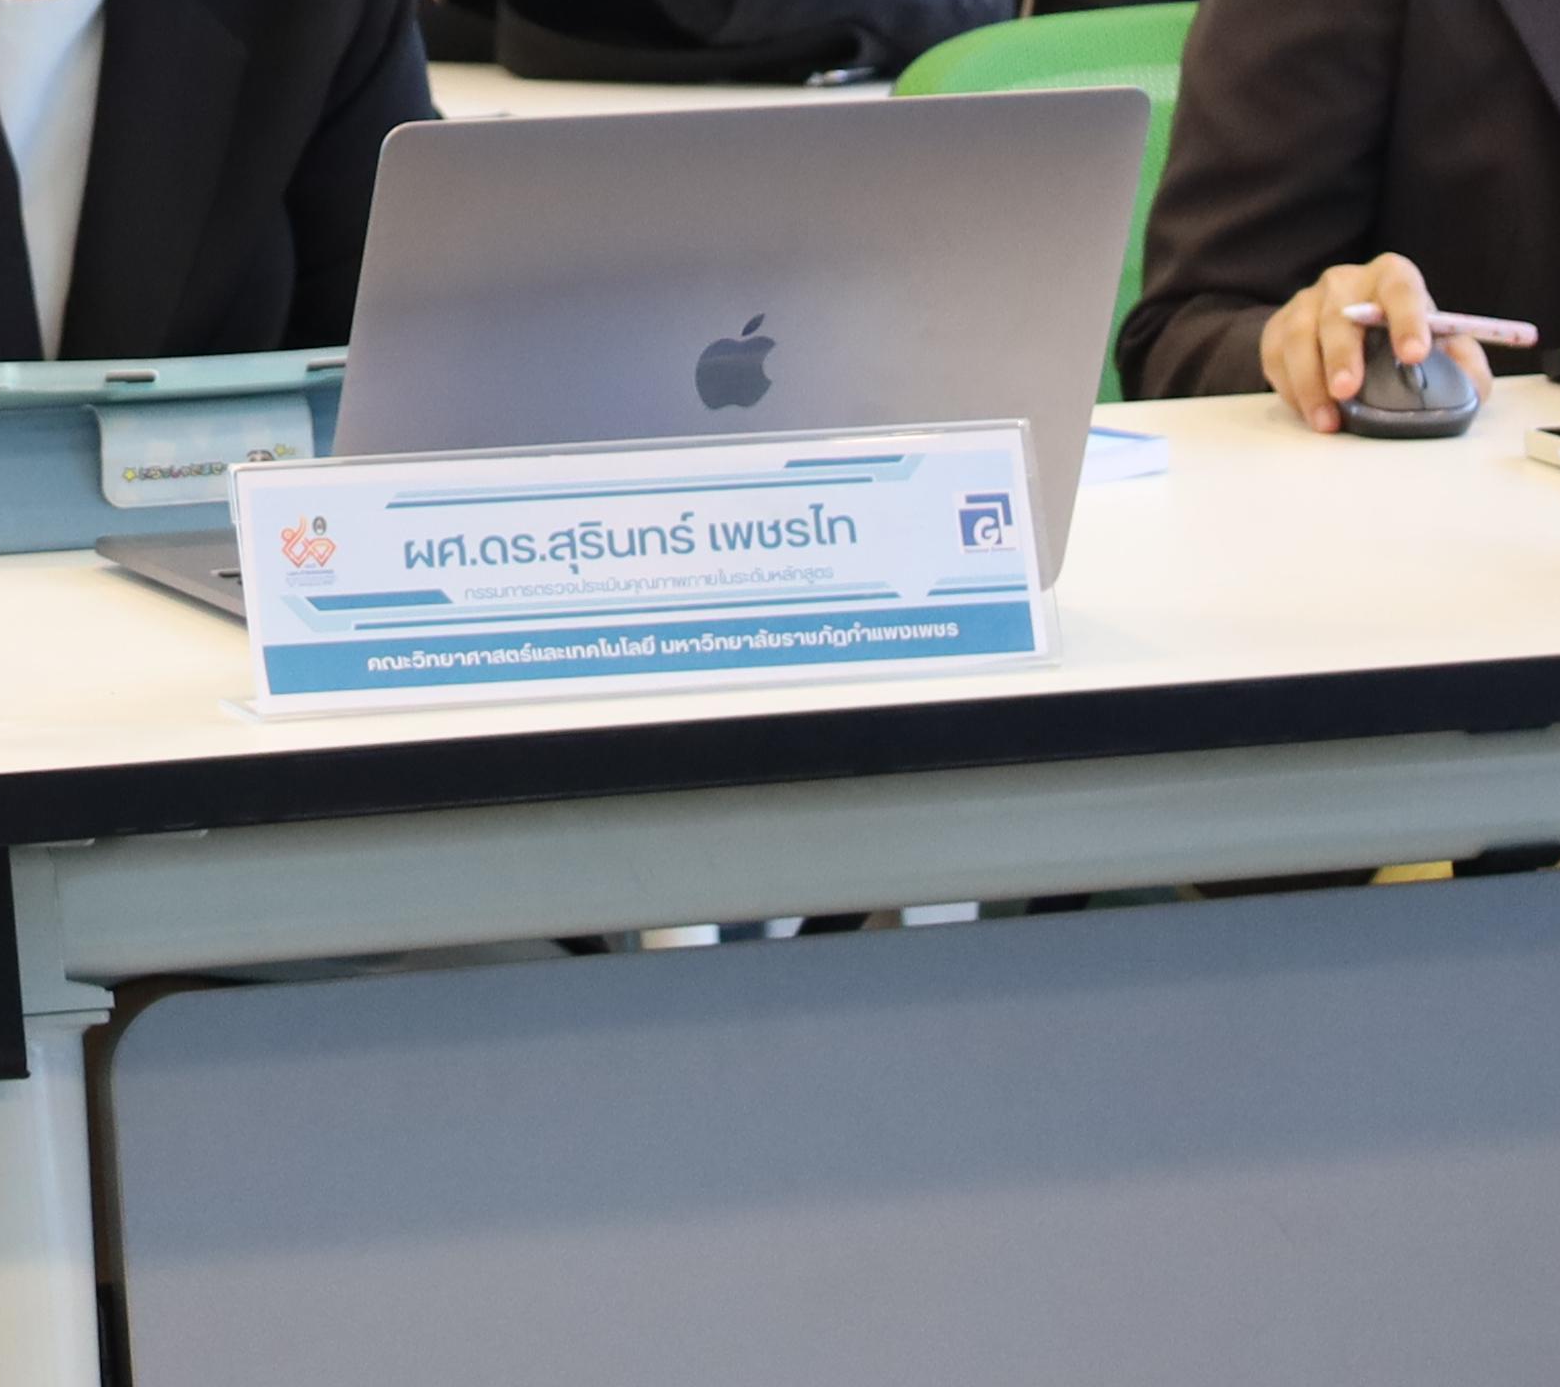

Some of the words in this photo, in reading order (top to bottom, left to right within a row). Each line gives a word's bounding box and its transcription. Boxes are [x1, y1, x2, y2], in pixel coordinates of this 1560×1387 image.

[402, 510, 696, 577] ผศ.ดร.สุรินทร์
[708, 502, 857, 552] เพชรไท
[367, 632, 655, 673] คณะวิทยาศาสตร์และเทคโนโลยี
